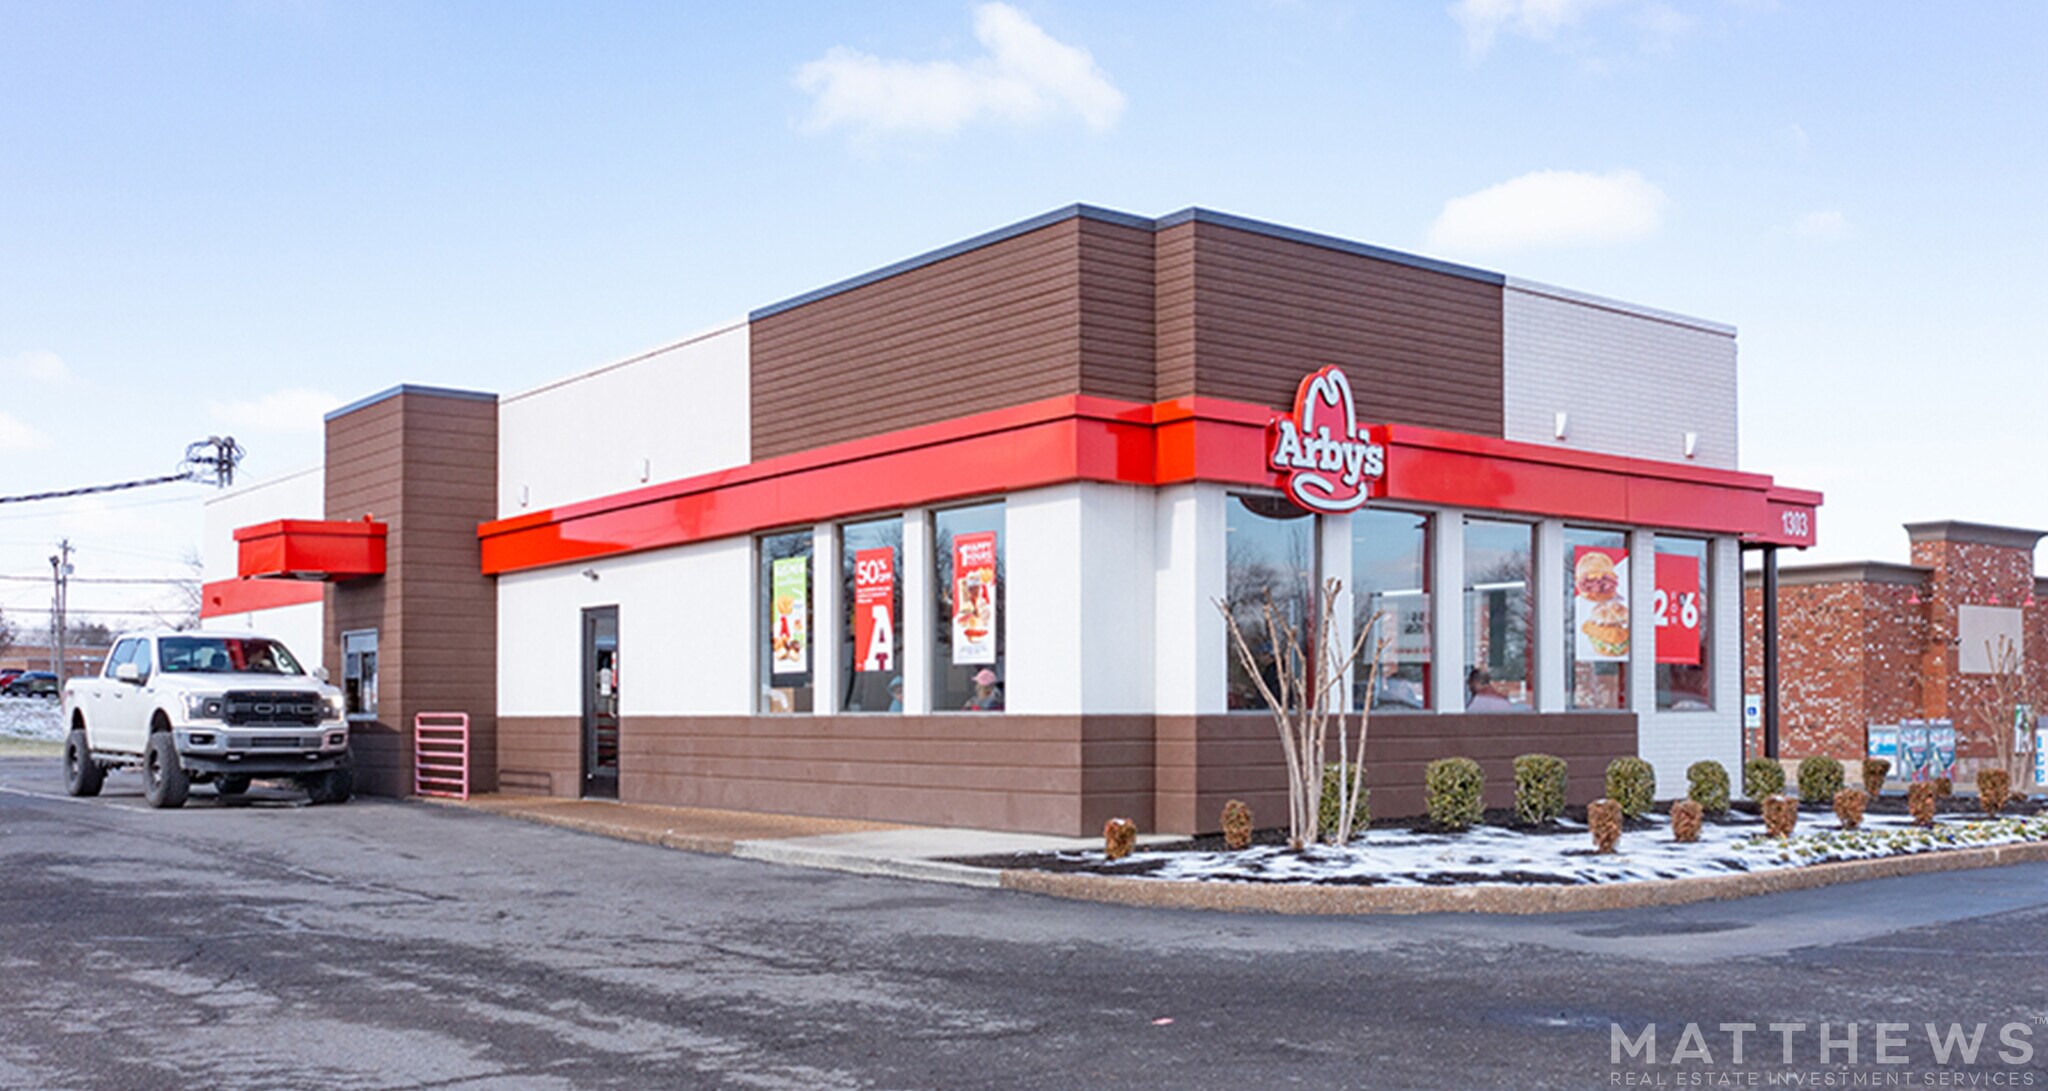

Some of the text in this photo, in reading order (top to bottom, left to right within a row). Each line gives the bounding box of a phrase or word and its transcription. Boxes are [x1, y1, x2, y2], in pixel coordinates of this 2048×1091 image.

[1274, 420, 1385, 486] Arby's
[1781, 510, 1809, 537] 1303
[1653, 589, 1668, 626] 2
[227, 702, 316, 715] FORD
